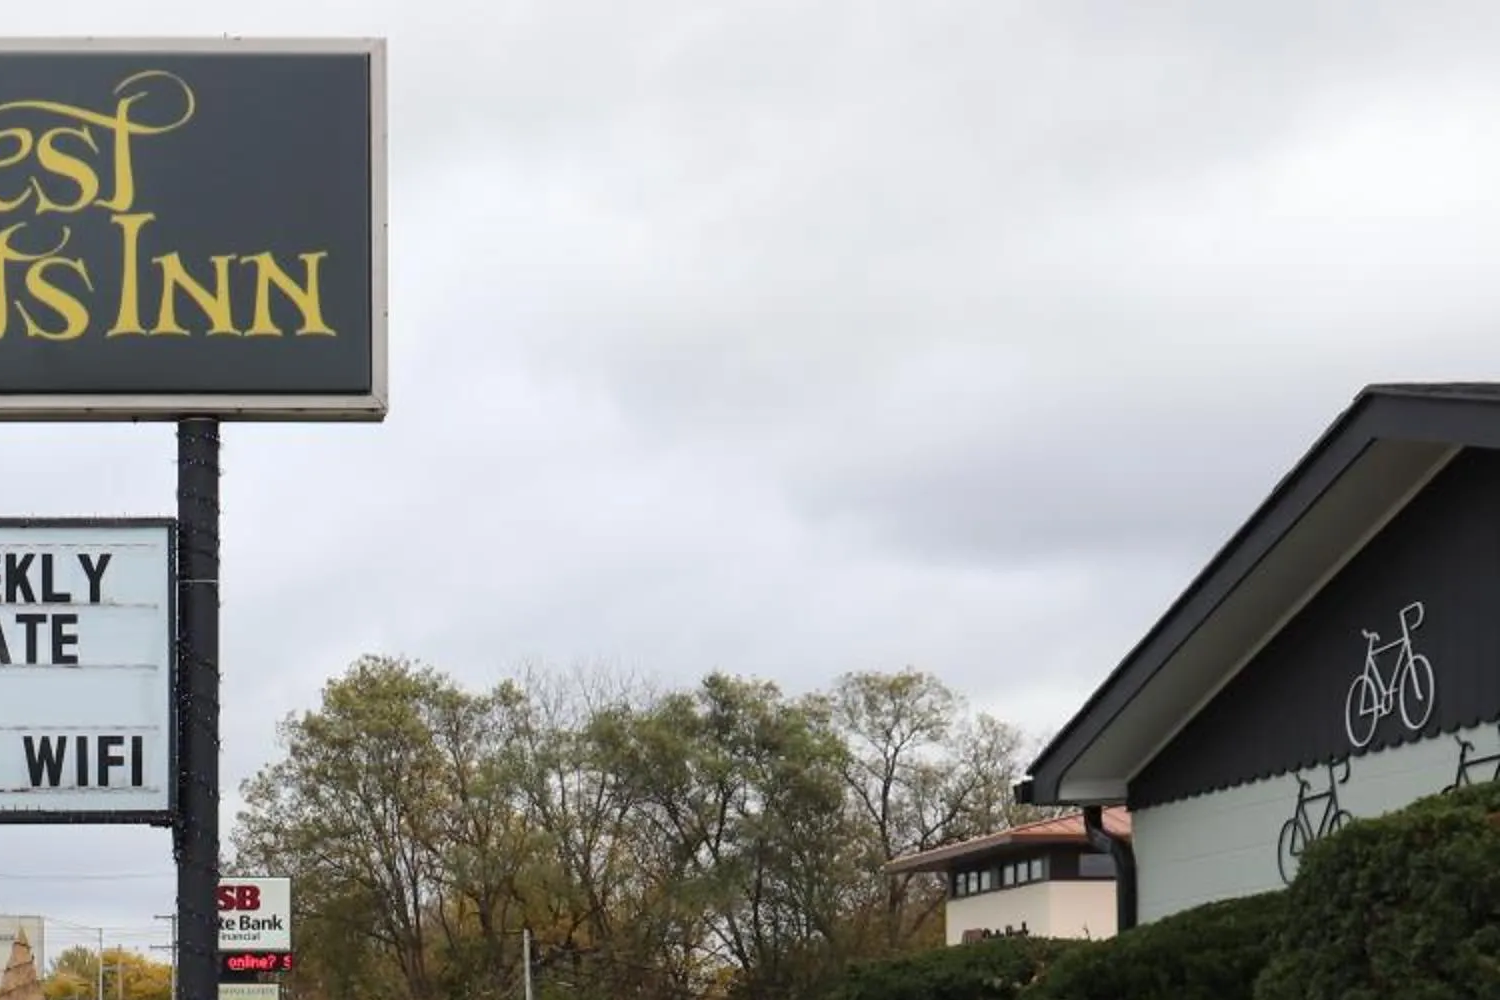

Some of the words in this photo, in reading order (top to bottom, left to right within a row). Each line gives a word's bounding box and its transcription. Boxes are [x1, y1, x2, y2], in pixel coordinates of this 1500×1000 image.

[24, 735, 144, 788] WIFI
[215, 885, 261, 912] SB
[239, 914, 284, 931] Bank
[220, 932, 261, 941] inancial
[228, 954, 277, 971] online?
